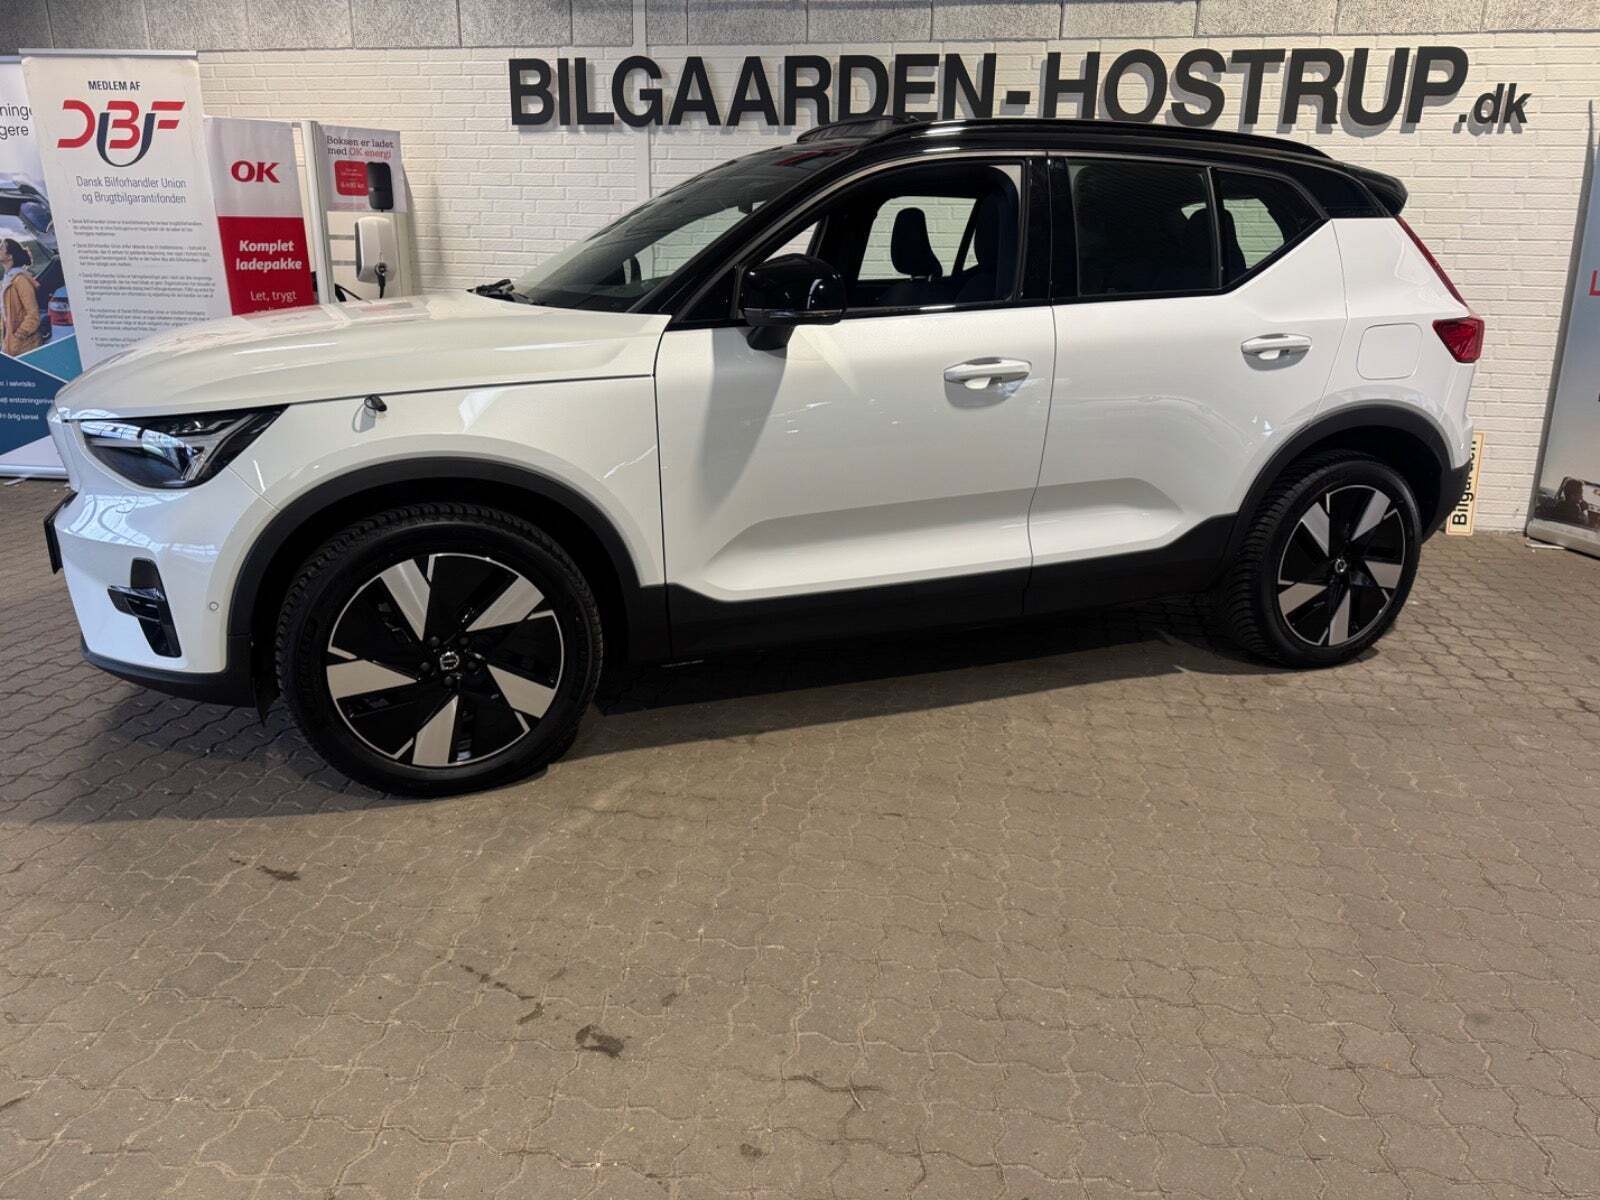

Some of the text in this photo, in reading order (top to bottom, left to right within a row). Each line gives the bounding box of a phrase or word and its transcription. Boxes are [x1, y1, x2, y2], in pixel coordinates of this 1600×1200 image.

[88, 81, 141, 90] MEDLEM AF
[0, 126, 29, 140] gere
[327, 136, 358, 146] Boksen
[372, 139, 394, 149] ladet
[328, 147, 347, 156] med
[231, 160, 281, 184] OK
[76, 176, 186, 189] Dansk Bilforhandler Union
[82, 192, 186, 205] og Brugtbilgarantifonden
[239, 239, 295, 255] Komplet
[235, 257, 302, 273] ladepakke
[250, 290, 297, 303] Let, trygt
